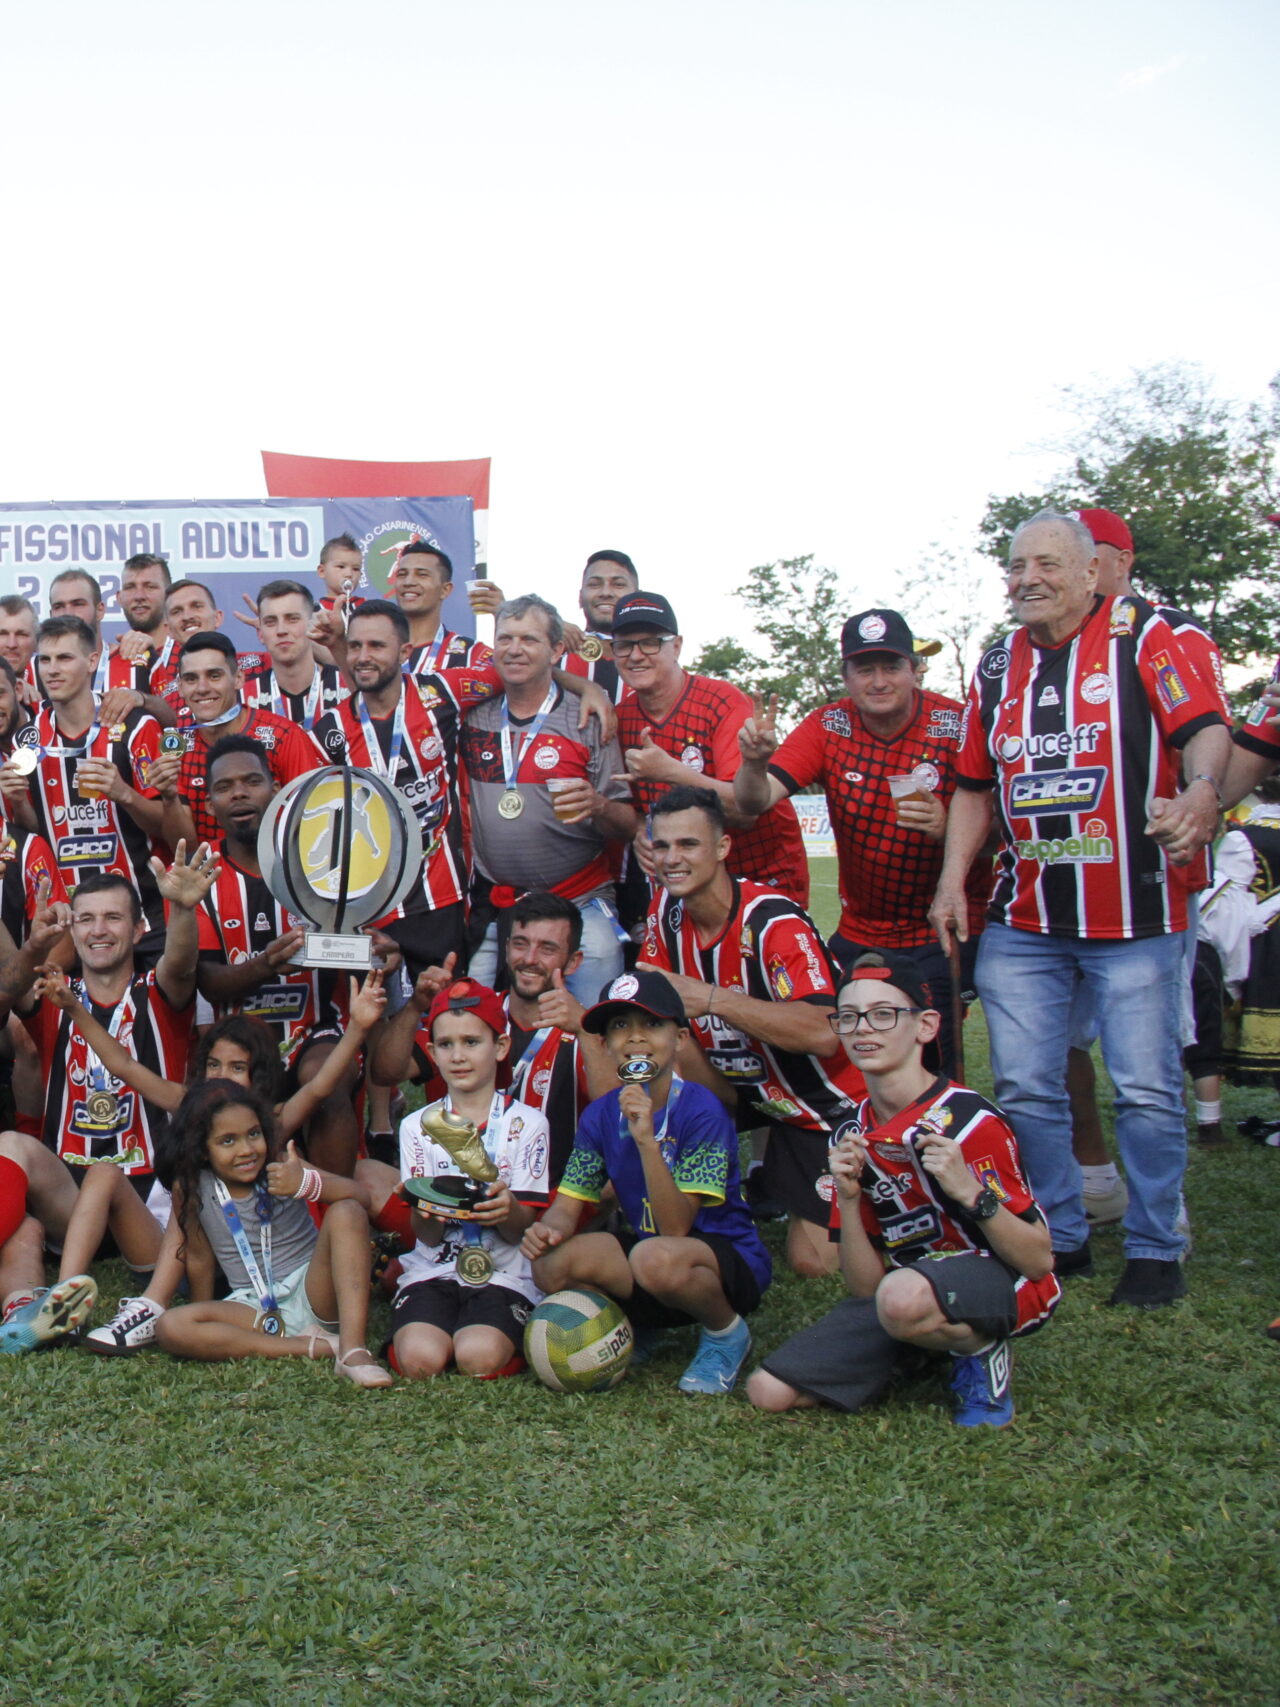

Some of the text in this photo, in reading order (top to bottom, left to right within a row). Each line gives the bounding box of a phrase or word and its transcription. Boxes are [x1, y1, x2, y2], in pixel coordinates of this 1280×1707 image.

[181, 520, 310, 559] ADULTO
[1012, 778, 1097, 802] CHICO
[60, 841, 113, 857] CHICO
[321, 950, 355, 961] CAMPEÃO
[243, 992, 302, 1011] CHICO
